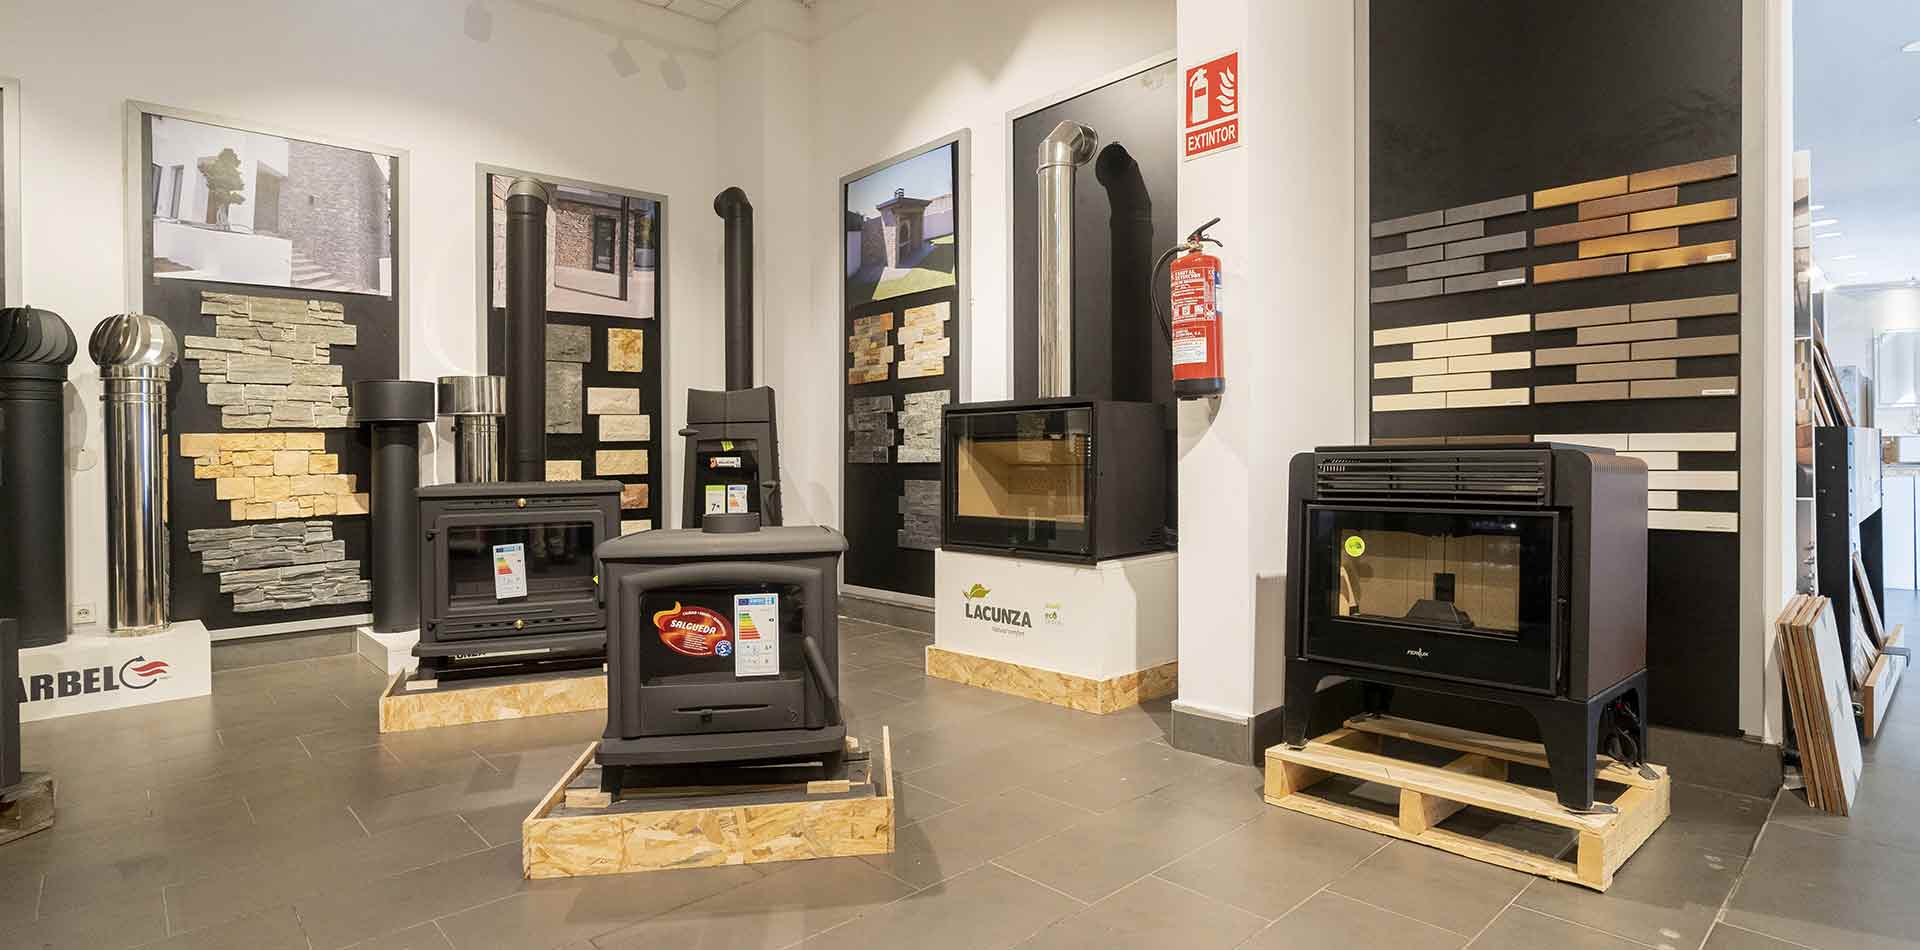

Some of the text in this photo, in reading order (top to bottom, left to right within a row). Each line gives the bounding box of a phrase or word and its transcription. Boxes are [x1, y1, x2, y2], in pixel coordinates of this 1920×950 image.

[1188, 124, 1236, 152] EXTINTOR
[670, 619, 717, 635] SALGUEDA
[965, 603, 1032, 628] LACUNZA
